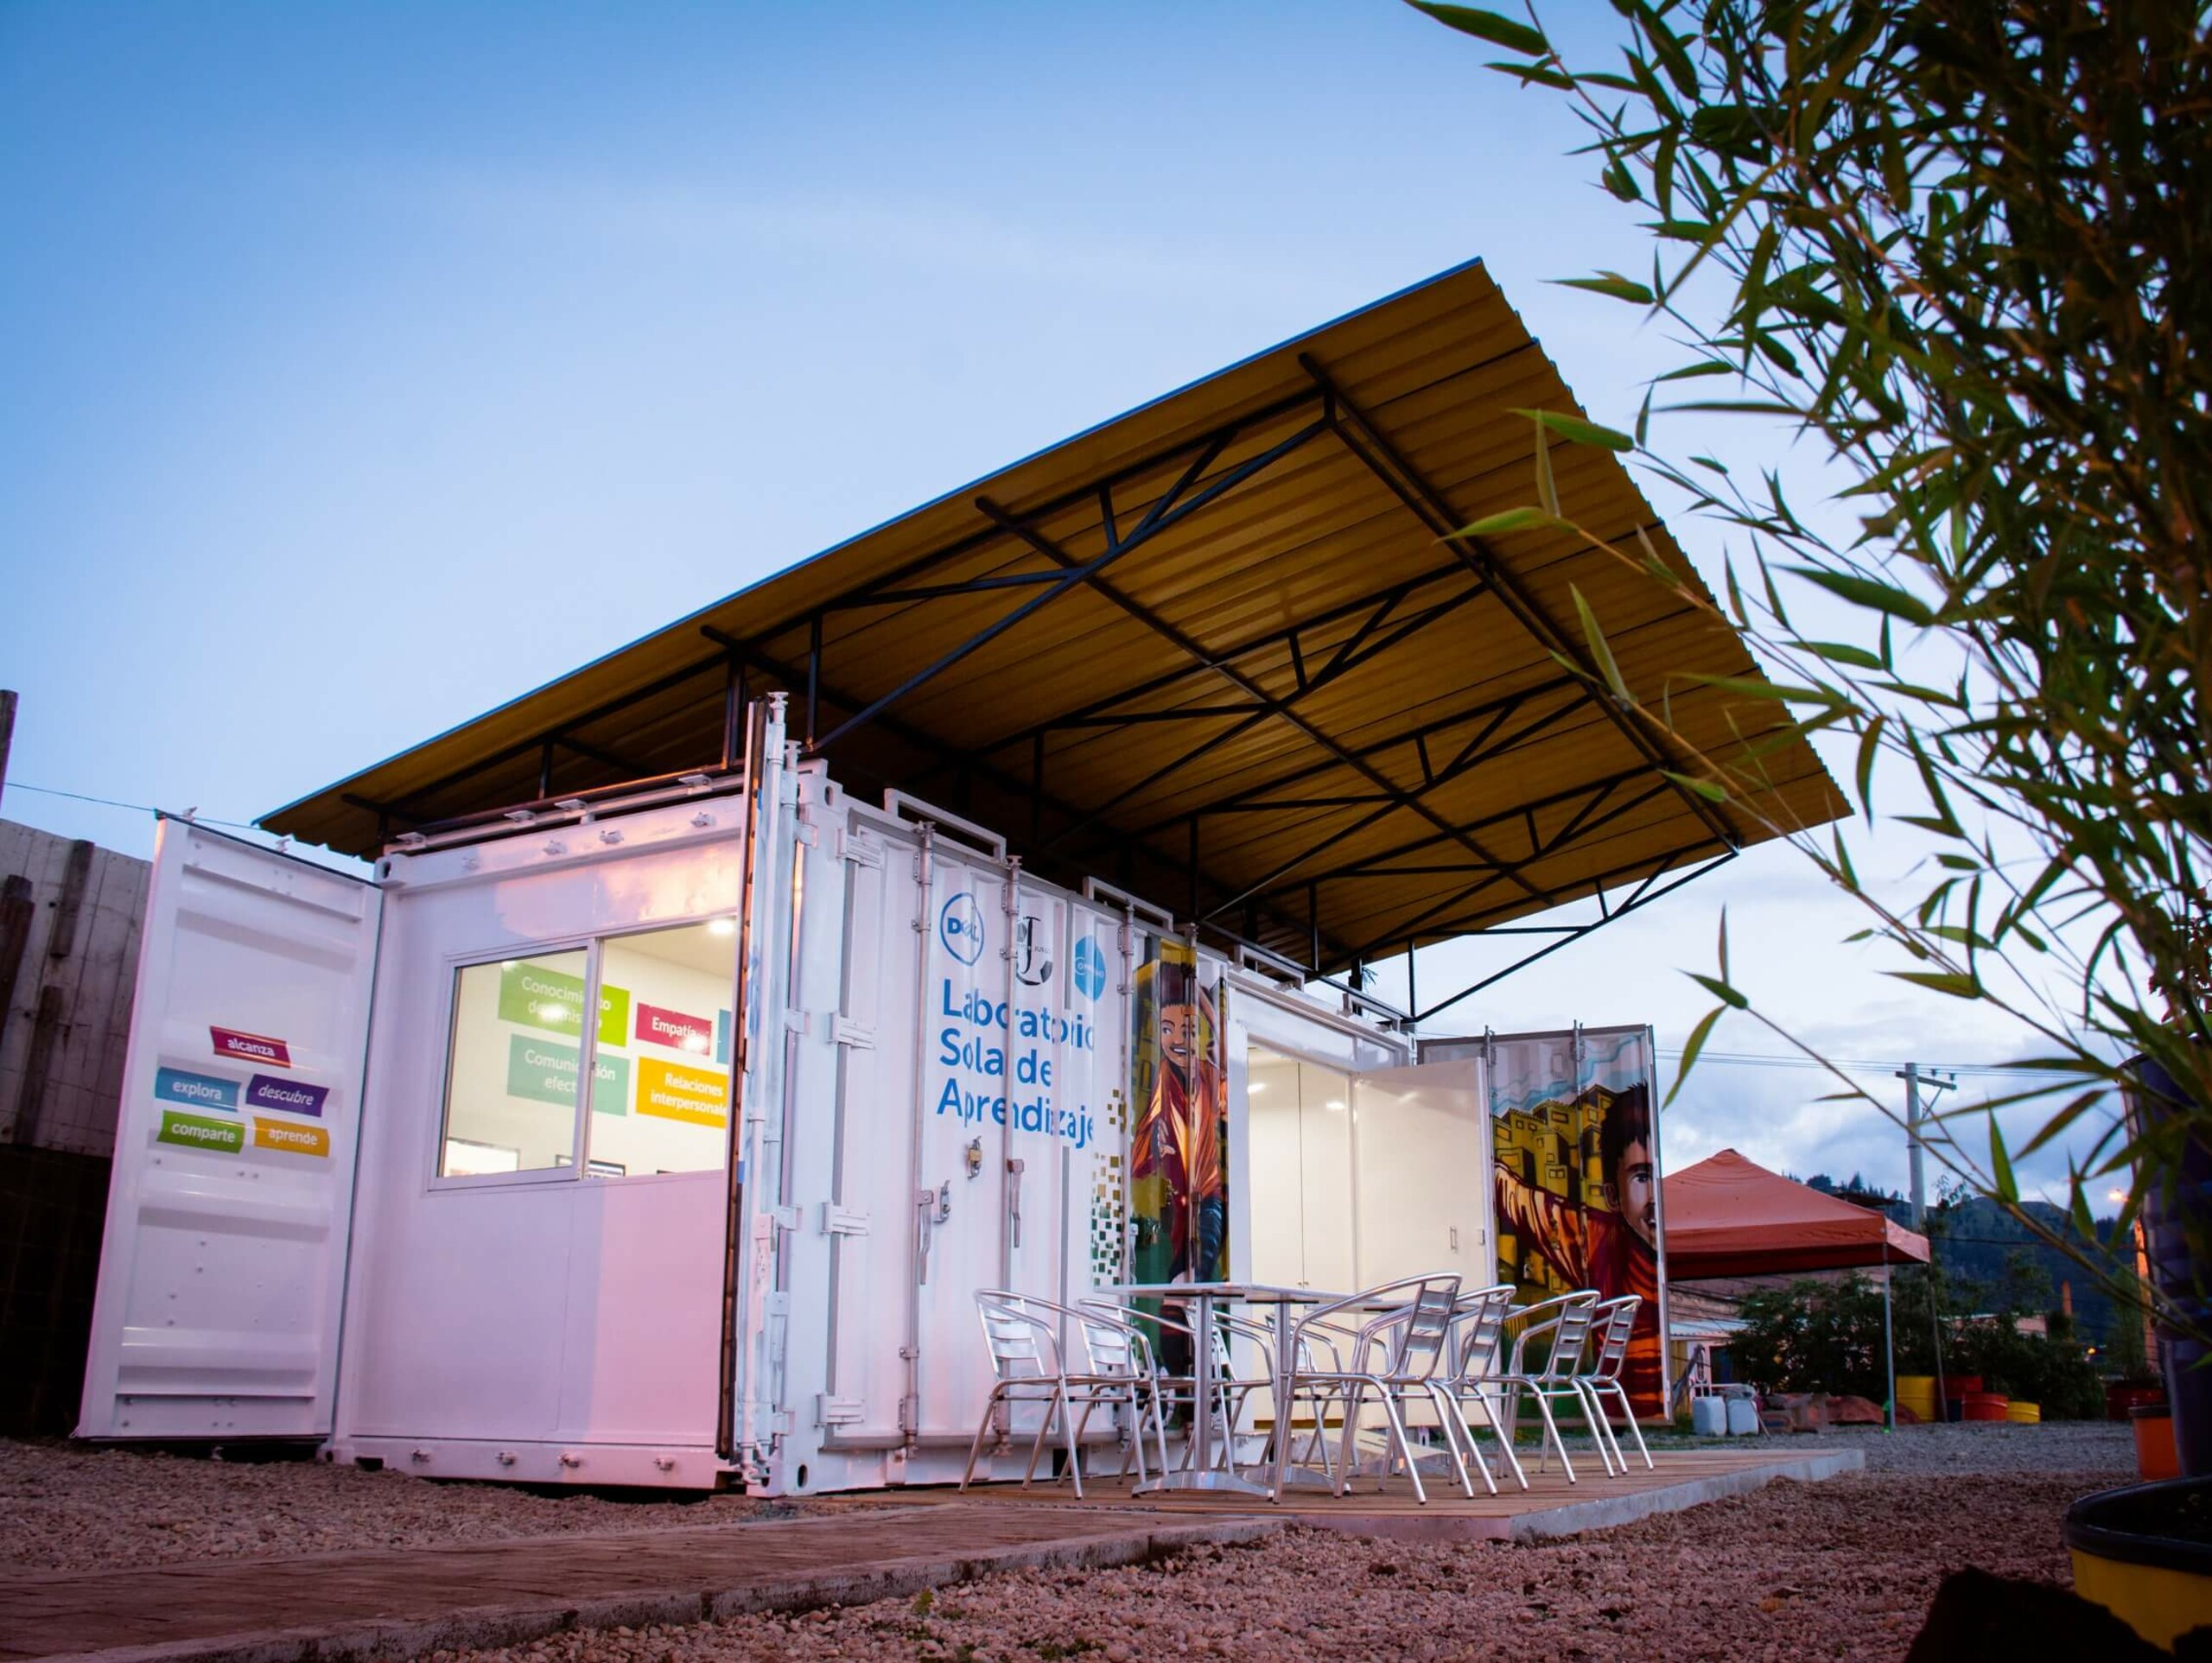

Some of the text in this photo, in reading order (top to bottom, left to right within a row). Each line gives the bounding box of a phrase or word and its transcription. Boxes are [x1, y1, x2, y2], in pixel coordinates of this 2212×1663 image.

[522, 976, 611, 1011] Conocimito
[227, 1038, 275, 1057] alcanza
[1017, 1049, 1052, 1087] de
[173, 1082, 314, 1106] explora descubre
[664, 1072, 723, 1097] Relaciones
[650, 1089, 728, 1116] interpersonale
[171, 1123, 317, 1146] comparte aprende
